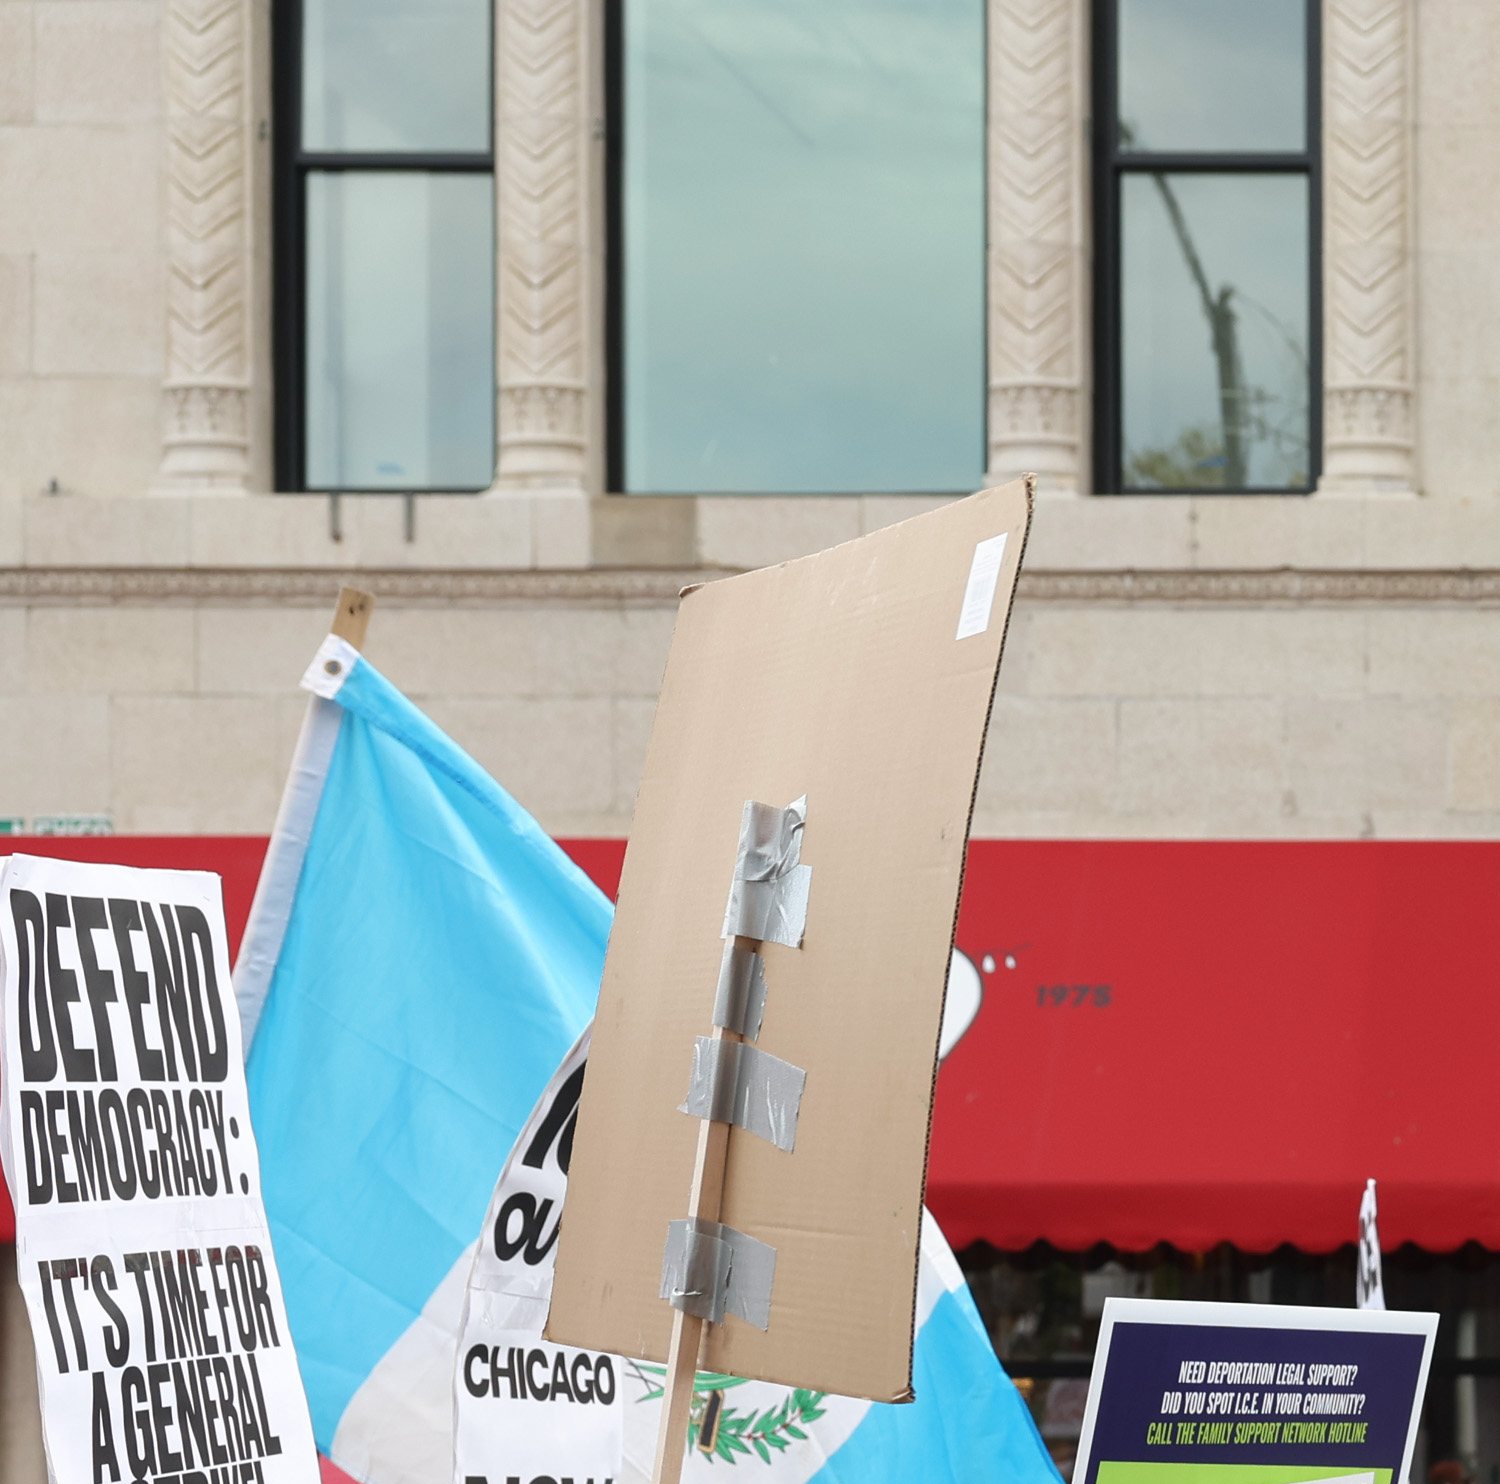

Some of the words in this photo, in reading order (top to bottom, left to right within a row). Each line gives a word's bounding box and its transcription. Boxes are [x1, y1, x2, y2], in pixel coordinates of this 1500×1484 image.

[10, 888, 229, 1083] DEFEND
[20, 1088, 250, 1206] DEMOCRACY:
[37, 1256, 131, 1375] IT'S
[124, 1249, 214, 1364] TIME
[208, 1244, 281, 1353] FOR
[120, 1353, 283, 1481] GENERAL
[464, 1342, 617, 1406] CHICAGO
[1161, 1392, 1183, 1415] DID
[1184, 1392, 1205, 1415] YOU
[1206, 1392, 1235, 1415] SPOT
[1235, 1393, 1259, 1415] I.C.E.
[1261, 1393, 1275, 1415] IN
[1275, 1393, 1303, 1415] YOUR
[1303, 1393, 1366, 1416] COMMUNITY?
[1178, 1361, 1207, 1385] NEED
[1207, 1362, 1276, 1386] DEPORTATION
[1276, 1363, 1305, 1386] LEGAL
[1307, 1364, 1358, 1387] SUPPORT?
[1147, 1422, 1173, 1446] CALL
[1175, 1422, 1197, 1445] THE
[1197, 1422, 1235, 1445] FAMILY
[1234, 1422, 1283, 1445] SUPPORT
[1281, 1422, 1328, 1444] NETWORK
[1327, 1422, 1369, 1444] HOTLINE
